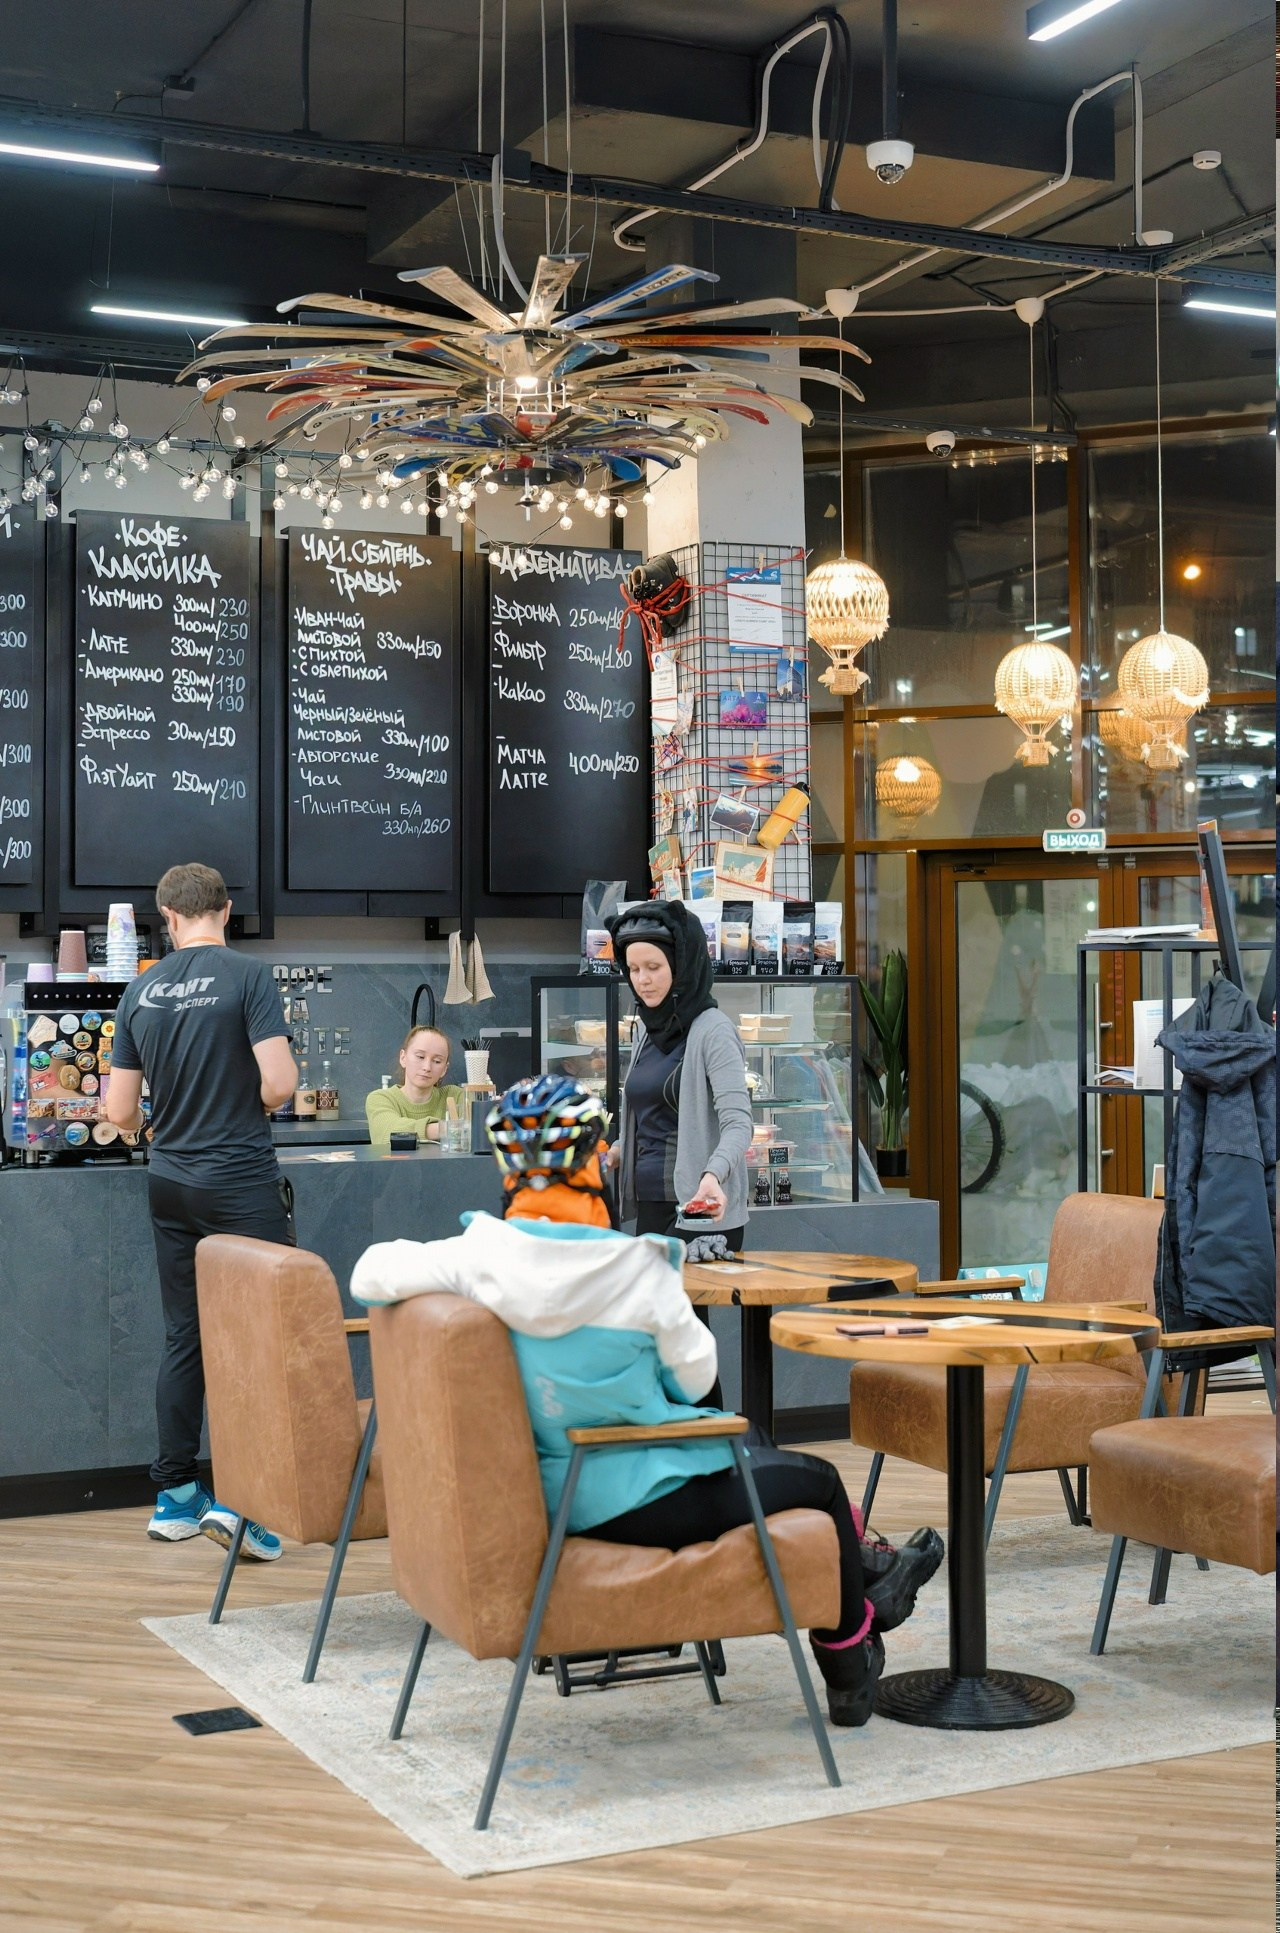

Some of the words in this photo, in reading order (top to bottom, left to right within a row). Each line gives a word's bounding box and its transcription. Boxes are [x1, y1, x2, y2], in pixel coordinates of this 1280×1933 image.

[120, 518, 181, 558] КОФЕ
[87, 545, 222, 589] КЛАССИКА
[326, 564, 398, 603] ТРАВЫ
[89, 627, 130, 655] ЛАТТЕ
[1050, 834, 1100, 847] ВЫХОД
[148, 976, 216, 999] КАНТ
[273, 965, 333, 993] ОФЕ
